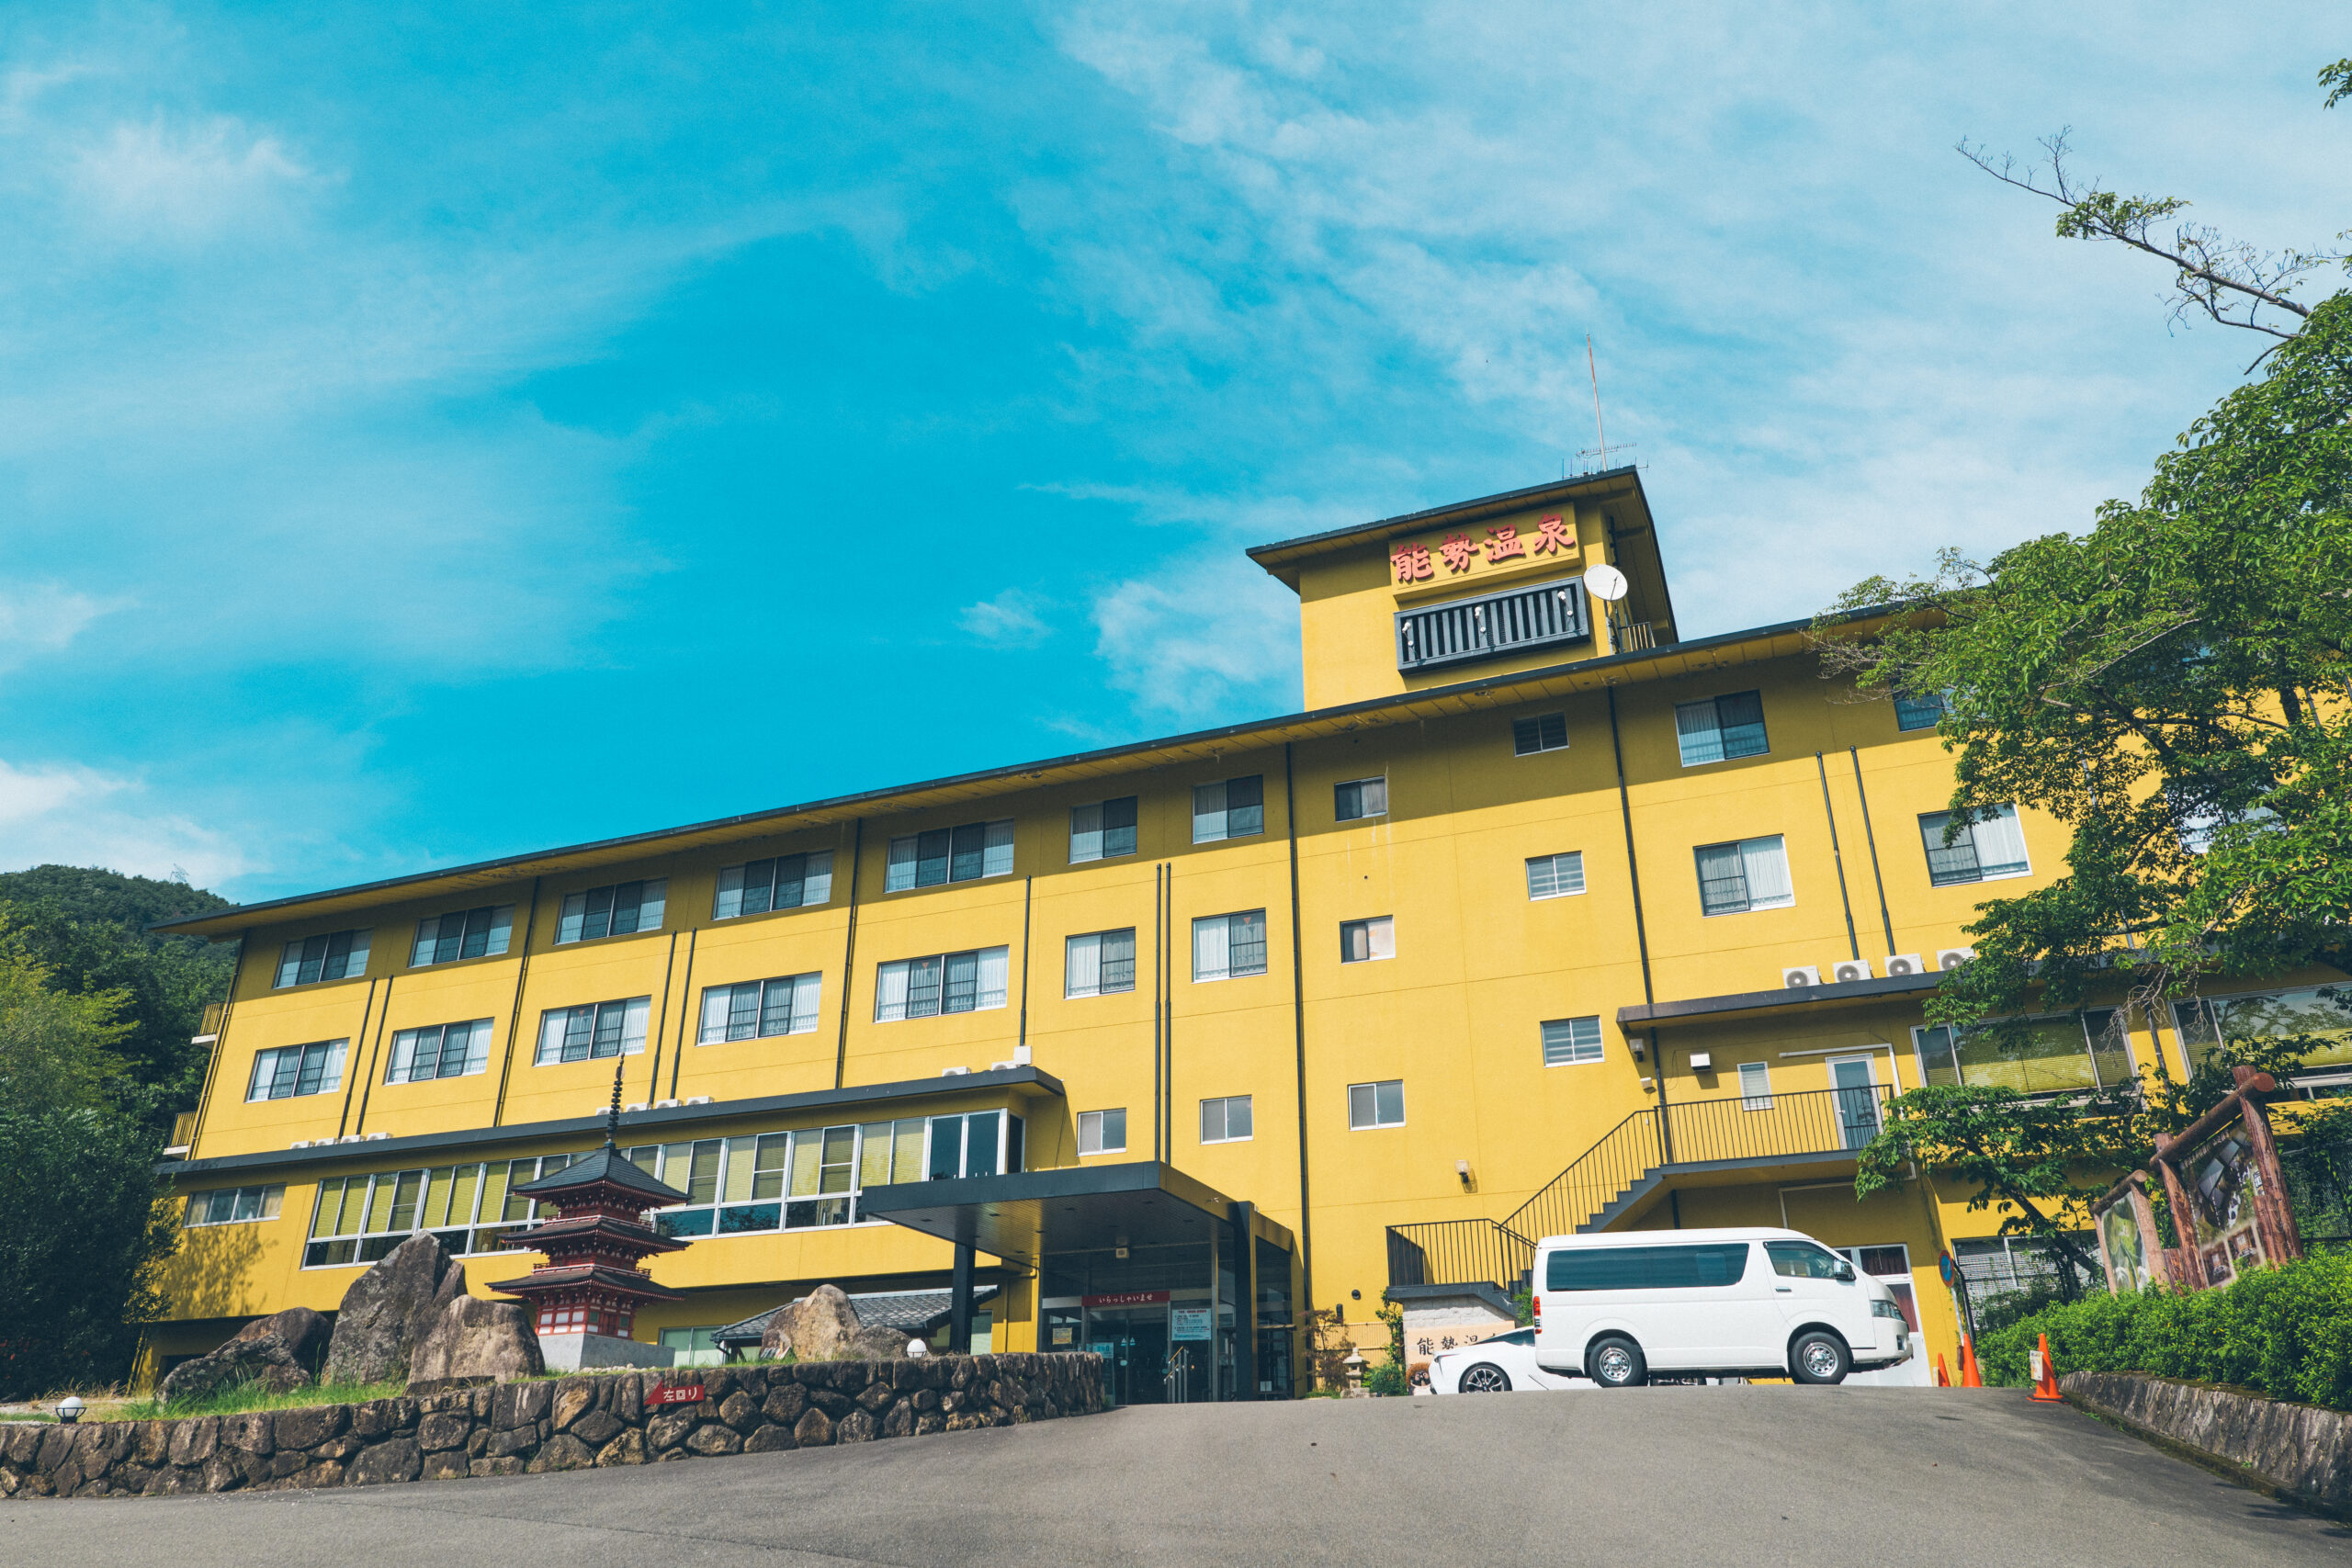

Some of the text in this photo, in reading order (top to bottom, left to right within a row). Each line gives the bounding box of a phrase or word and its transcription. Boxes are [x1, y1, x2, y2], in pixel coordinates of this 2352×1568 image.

[1390, 513, 1576, 581] 能勢温泉
[1099, 1293, 1154, 1304] いらっしゃいませ
[663, 1387, 697, 1402] 左回り
